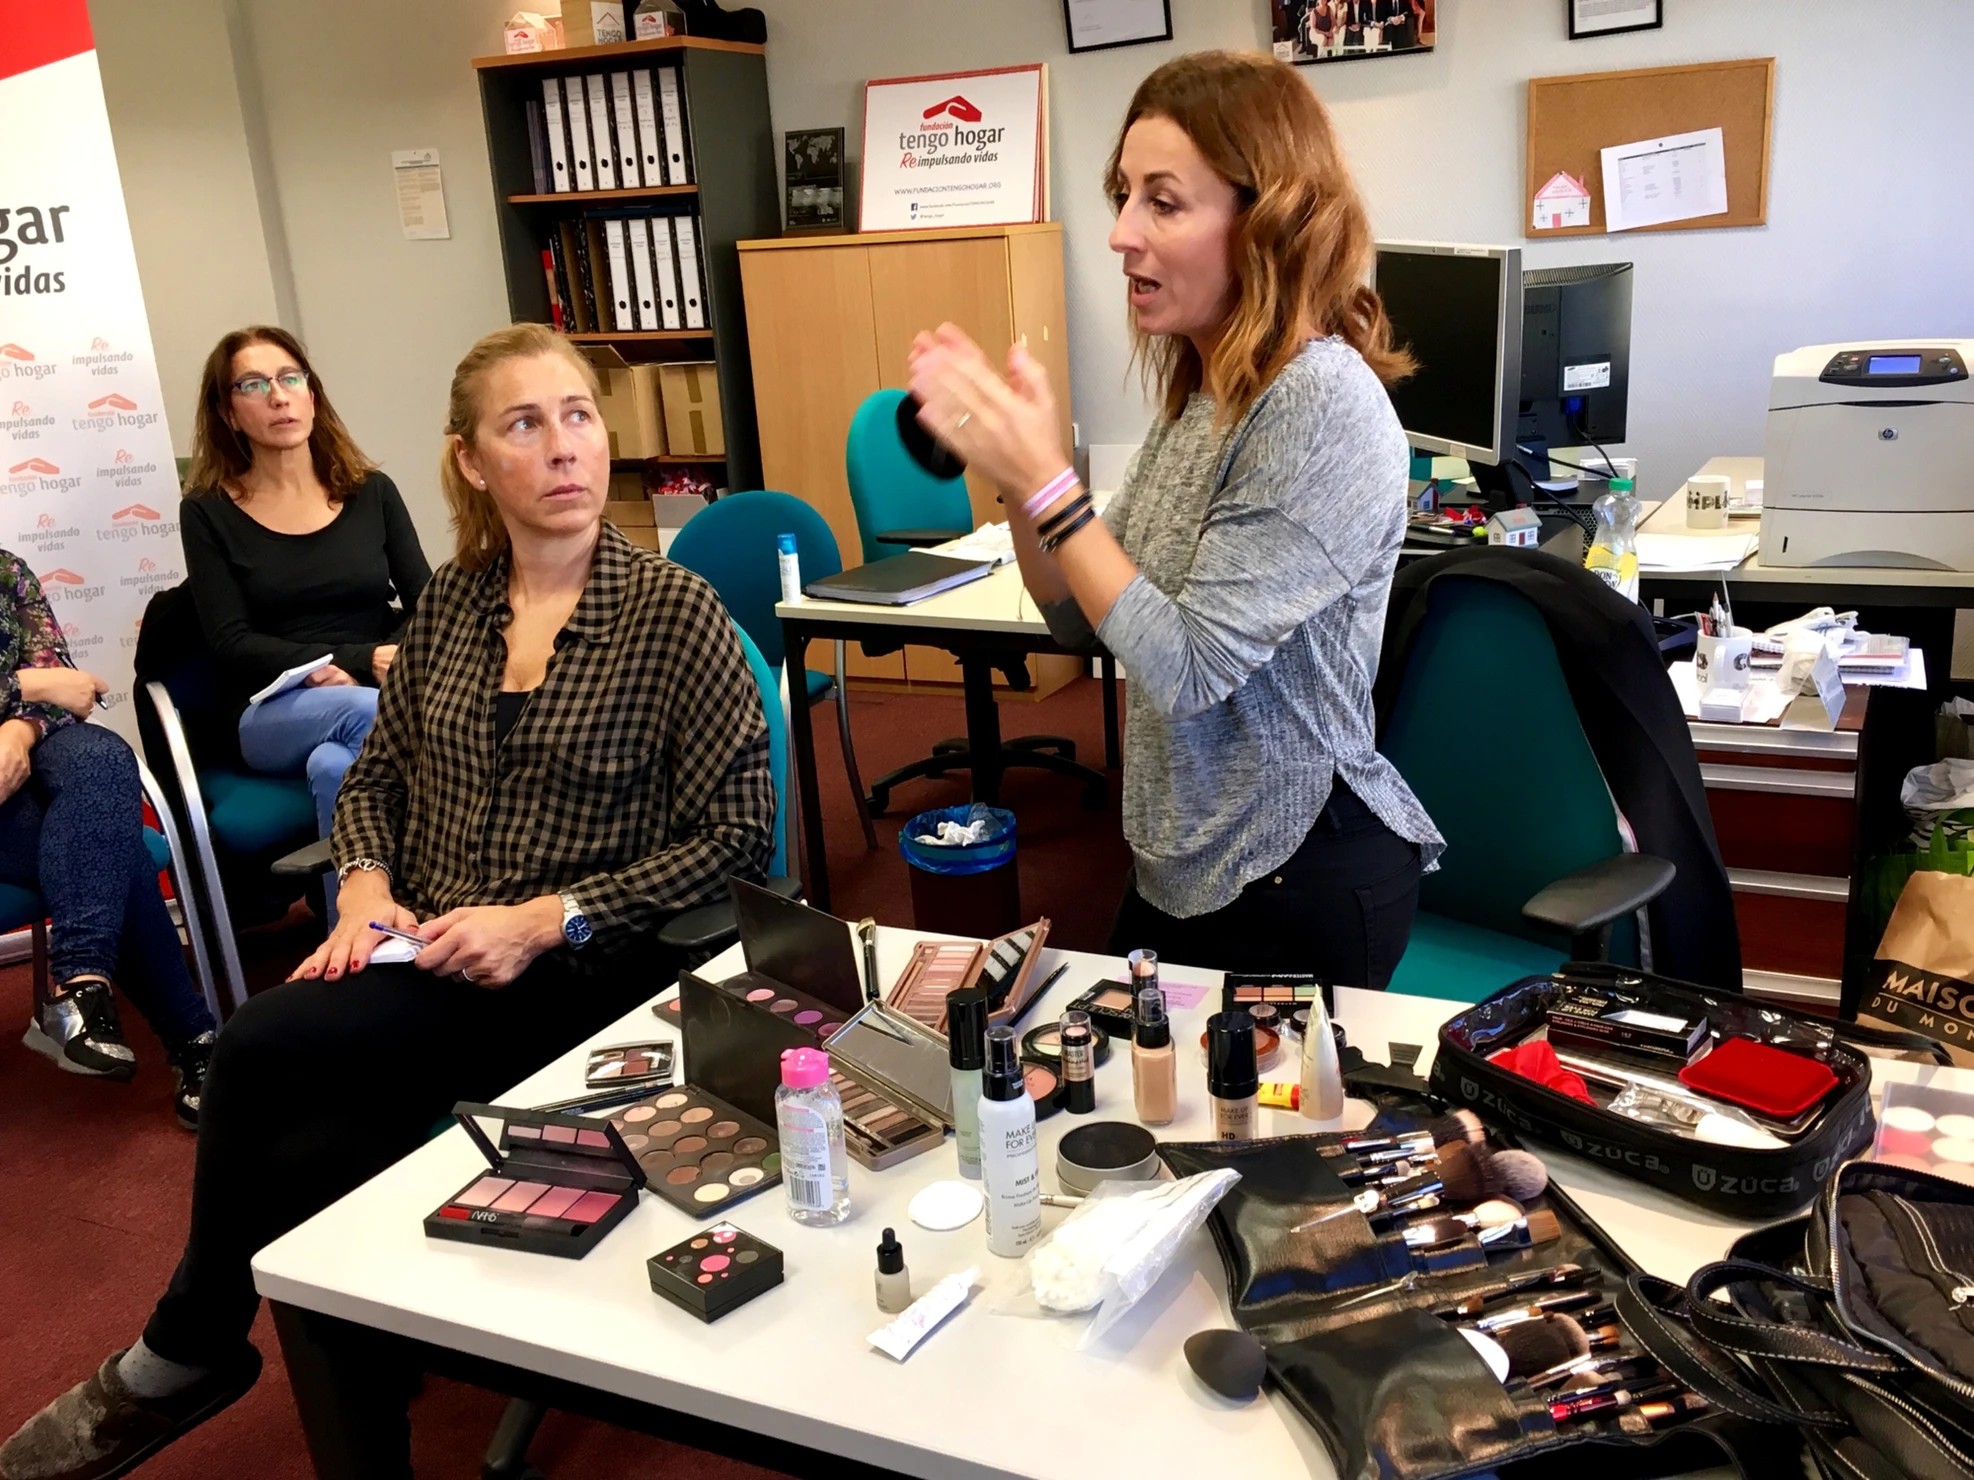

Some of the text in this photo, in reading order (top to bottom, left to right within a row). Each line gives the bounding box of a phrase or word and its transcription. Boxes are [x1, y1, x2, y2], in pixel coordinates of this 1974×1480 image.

[899, 125, 1005, 154] tengo hogar
[974, 151, 998, 163] vidas
[0, 265, 66, 296] idas
[72, 352, 134, 366] impulsando
[14, 364, 57, 380] hogar
[91, 365, 119, 376] vidas
[11, 400, 30, 416] Re
[72, 413, 159, 433] tengo hogar
[12, 429, 40, 441] vidas
[114, 449, 134, 464] Re
[96, 463, 157, 478] impulsando
[39, 476, 82, 493] hogar
[114, 476, 142, 488] vidas
[36, 513, 56, 529] Re
[18, 526, 81, 543] impulsando
[96, 526, 138, 543] tengo
[37, 541, 65, 553] vidas
[138, 557, 157, 572] Re
[120, 570, 179, 587] impulsando
[64, 585, 106, 602] hogar
[1871, 997, 1899, 1013] DU
[1006, 1124, 1030, 1139] MAKE
[1221, 1131, 1235, 1141] HD
[1006, 1138, 1024, 1149] FOR
[1015, 1175, 1030, 1187] MIST
